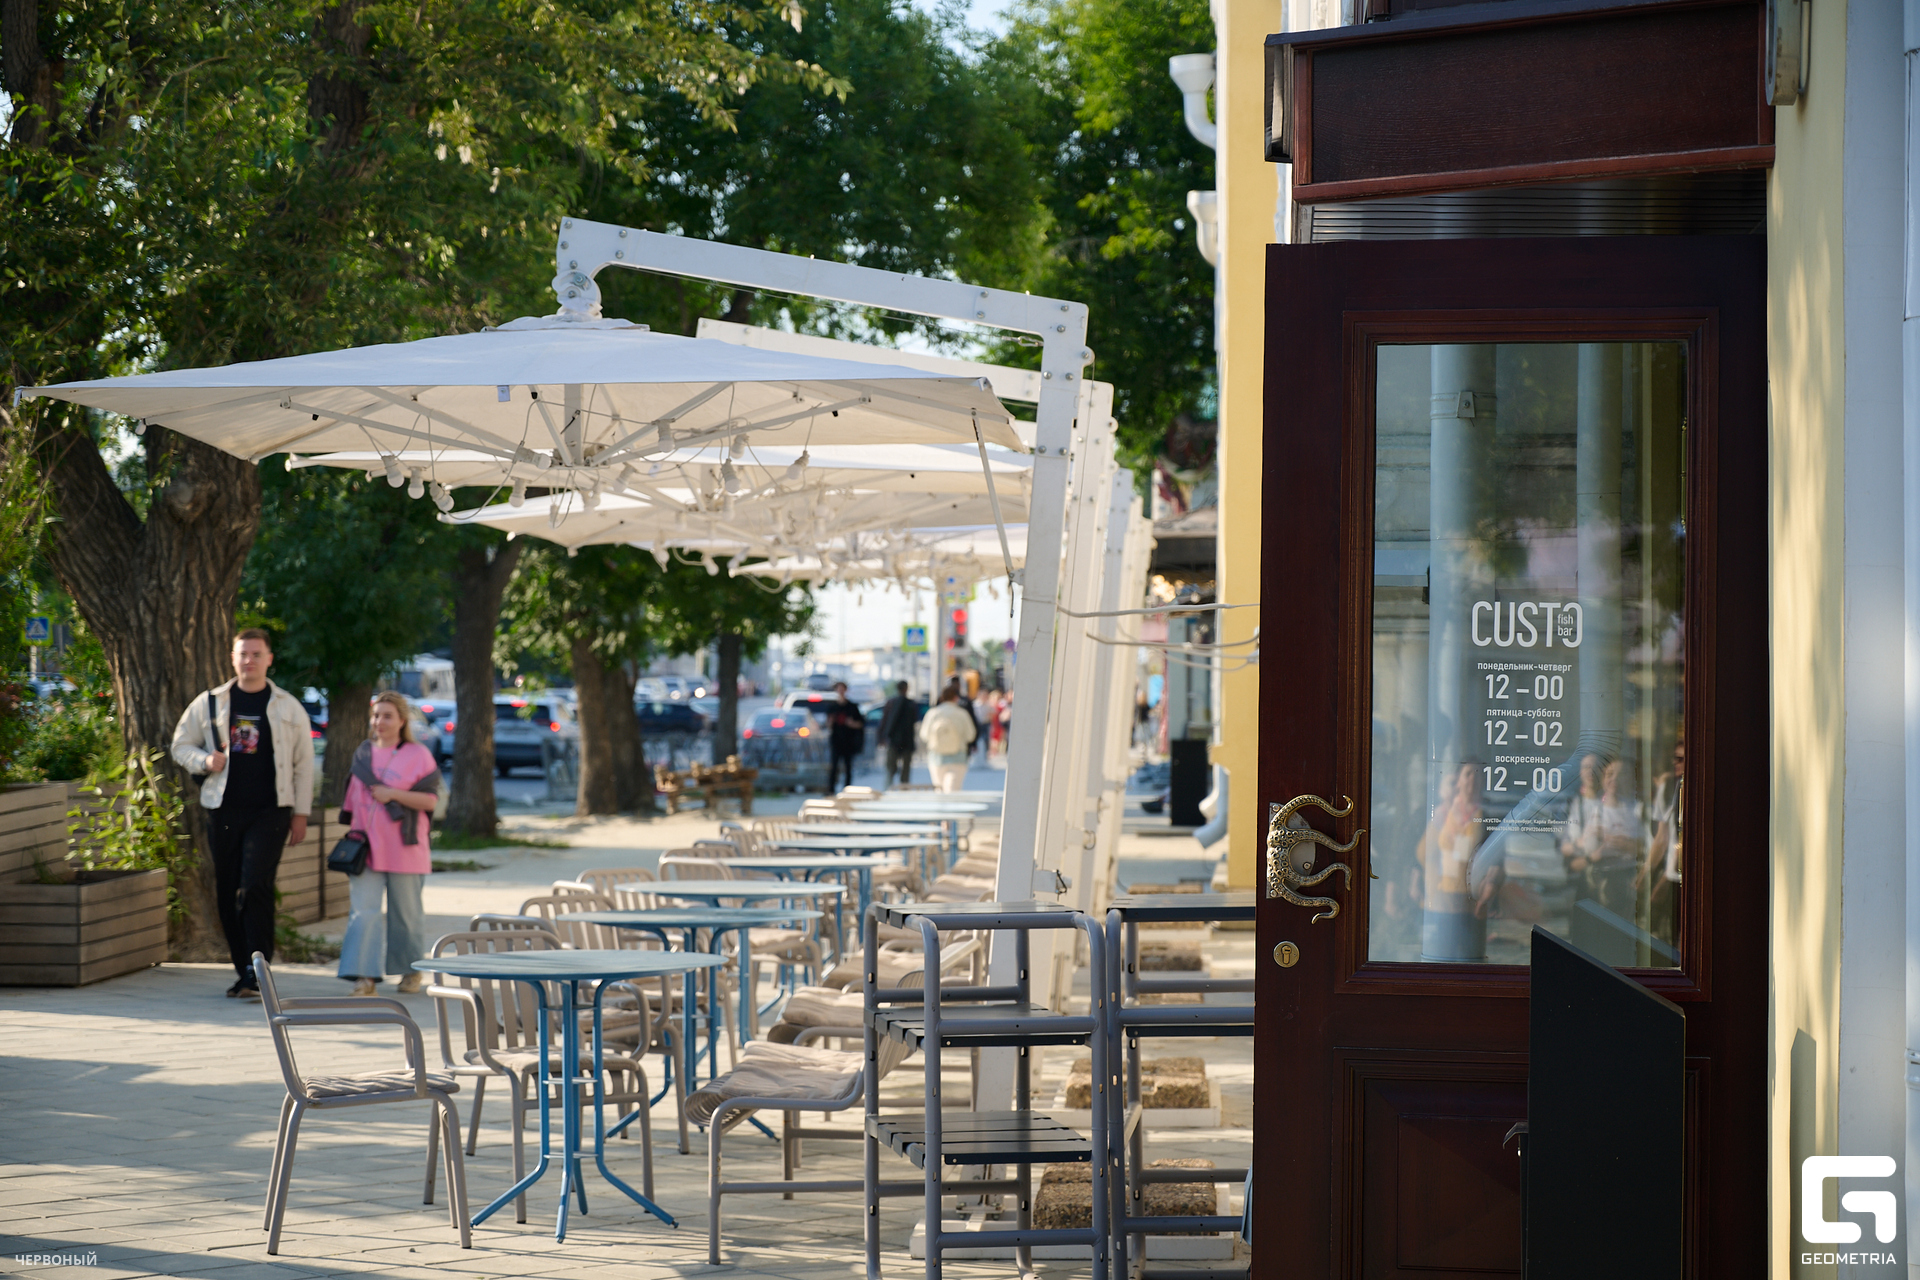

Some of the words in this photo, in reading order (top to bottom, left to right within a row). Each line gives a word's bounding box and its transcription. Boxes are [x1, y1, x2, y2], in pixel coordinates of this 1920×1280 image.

[1557, 613, 1574, 625] fish
[1557, 625, 1573, 636] bar
[1485, 674, 1510, 699] 12
[1534, 674, 1564, 700] 00
[1484, 720, 1509, 745] 12
[1533, 720, 1563, 746] 02
[1495, 755, 1551, 765] воскресенье
[1483, 766, 1508, 791] 12
[1532, 767, 1562, 793] 00
